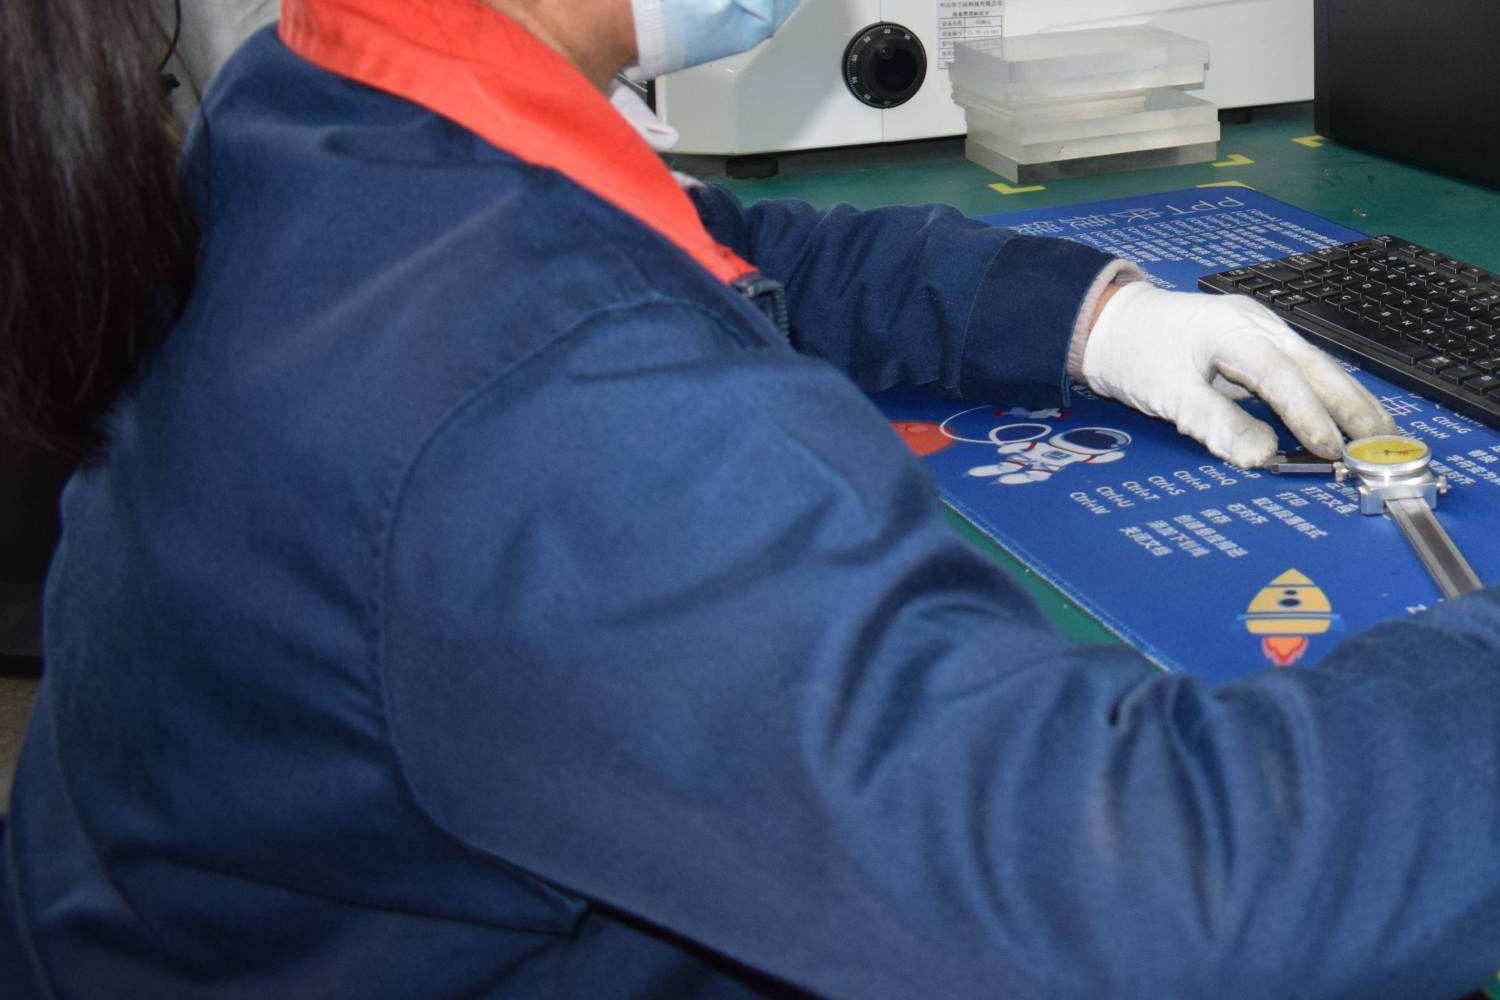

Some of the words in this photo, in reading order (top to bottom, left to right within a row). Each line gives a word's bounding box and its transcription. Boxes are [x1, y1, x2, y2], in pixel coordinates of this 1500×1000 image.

[1165, 196, 1244, 216] PPT
[1410, 420, 1451, 439] Ctrl+H
[1432, 416, 1472, 434] Ctrl+G
[1148, 475, 1187, 497] Ctrl+S
[1173, 470, 1211, 492] Ctrl+R
[1198, 464, 1238, 487] Ctrl+Q
[1096, 485, 1136, 509] Ctrl+U
[1122, 480, 1161, 502] Ctrl+T
[1275, 491, 1310, 508] 打印
[1301, 486, 1360, 517] 打开文档
[1069, 491, 1112, 516] Ctrl+W
[1226, 502, 1270, 525] 右对齐
[1200, 508, 1233, 525] 保存
[1119, 525, 1174, 558] 关闭文档
